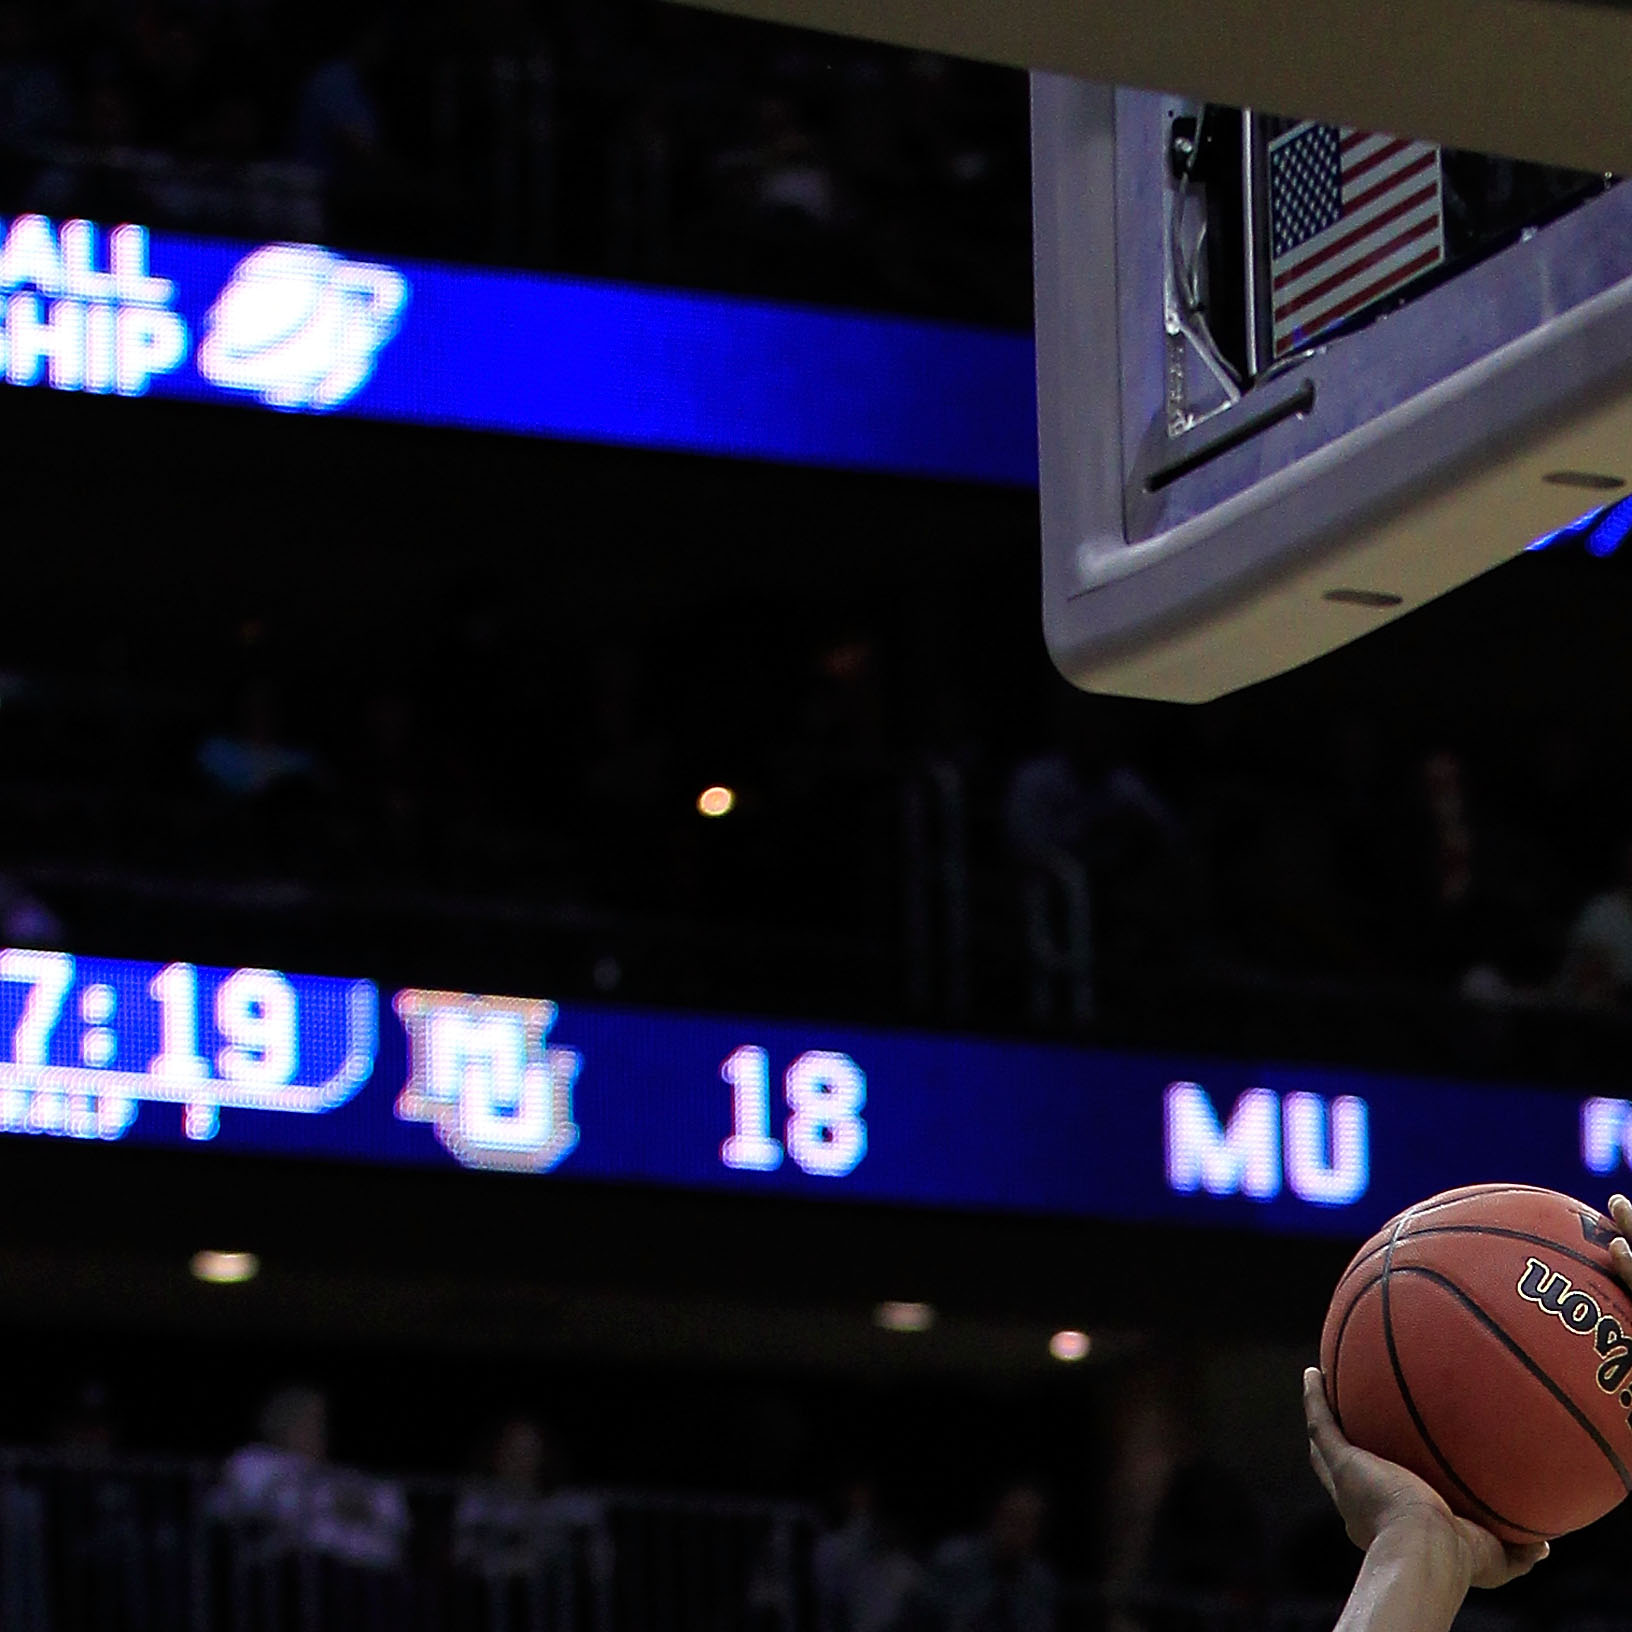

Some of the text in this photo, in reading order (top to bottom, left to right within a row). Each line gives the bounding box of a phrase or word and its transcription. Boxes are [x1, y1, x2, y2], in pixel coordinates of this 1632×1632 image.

[0, 290, 190, 396] HIP
[719, 1044, 868, 1176] 18
[1163, 1080, 1372, 1206] MU
